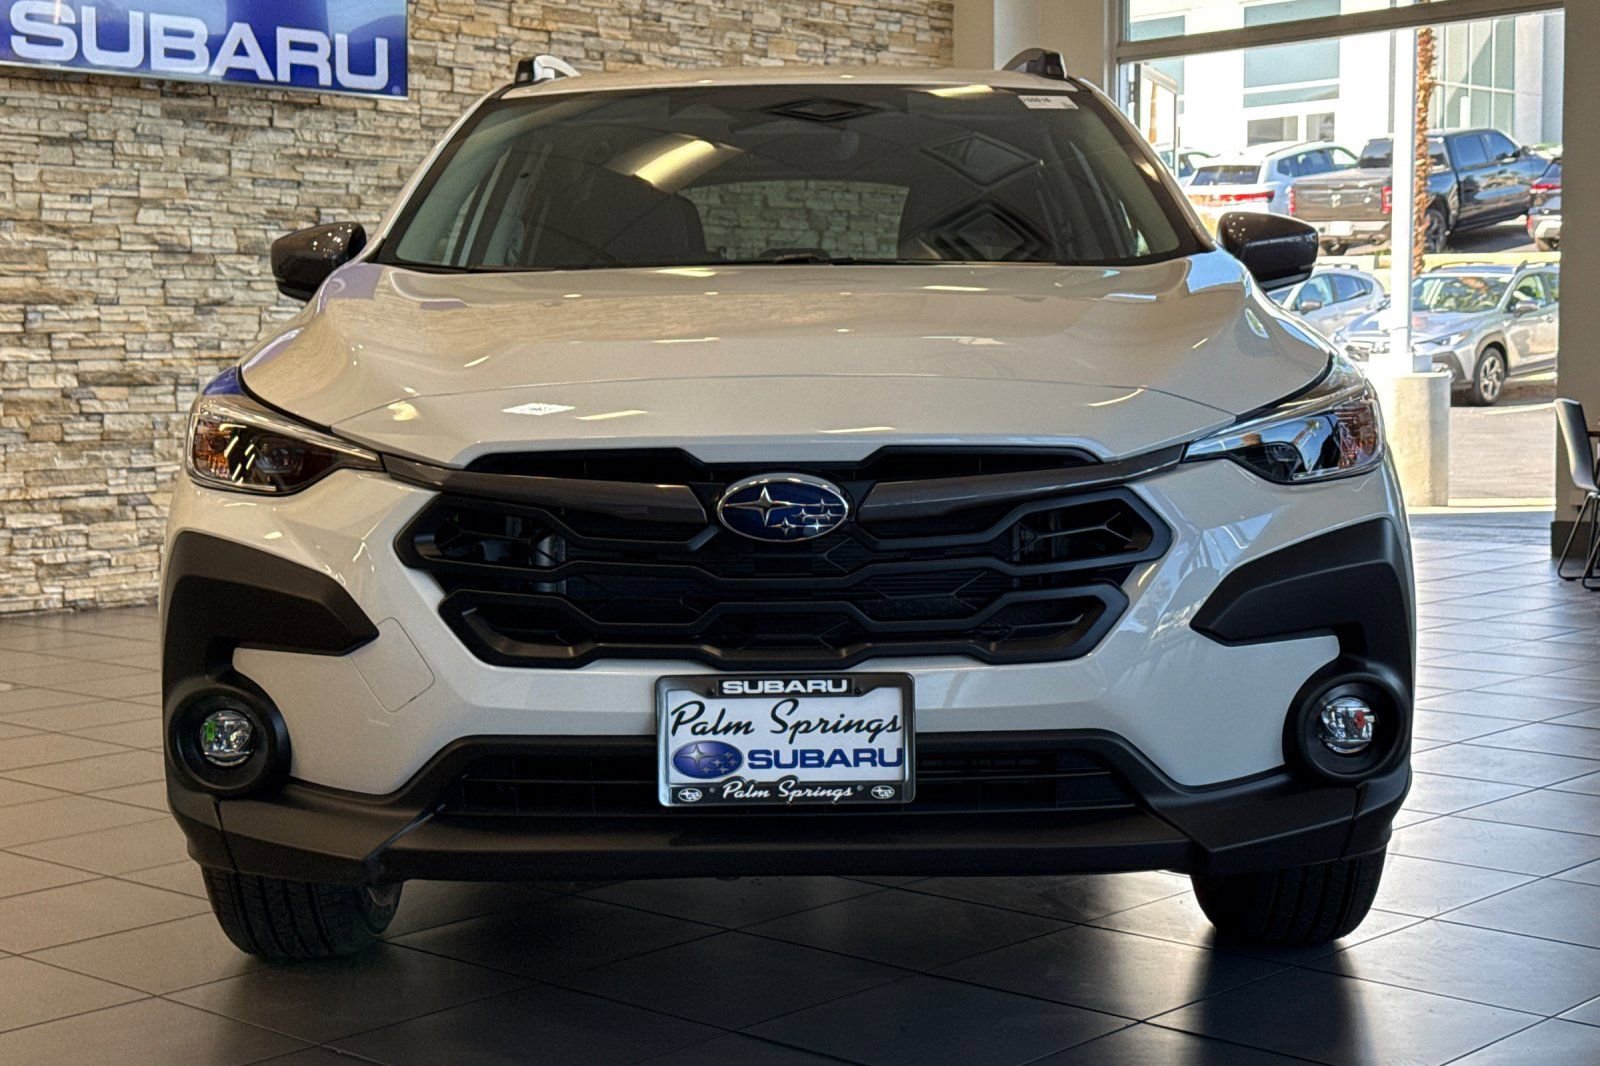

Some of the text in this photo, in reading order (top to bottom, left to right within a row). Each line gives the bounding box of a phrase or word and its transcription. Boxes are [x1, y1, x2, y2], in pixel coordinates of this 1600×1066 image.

[9, 0, 389, 91] SUBARU
[722, 679, 848, 694] SUBARU
[670, 698, 903, 744] Palm Springs
[747, 748, 903, 769] SUBARU
[722, 780, 854, 804] Palm Springs
